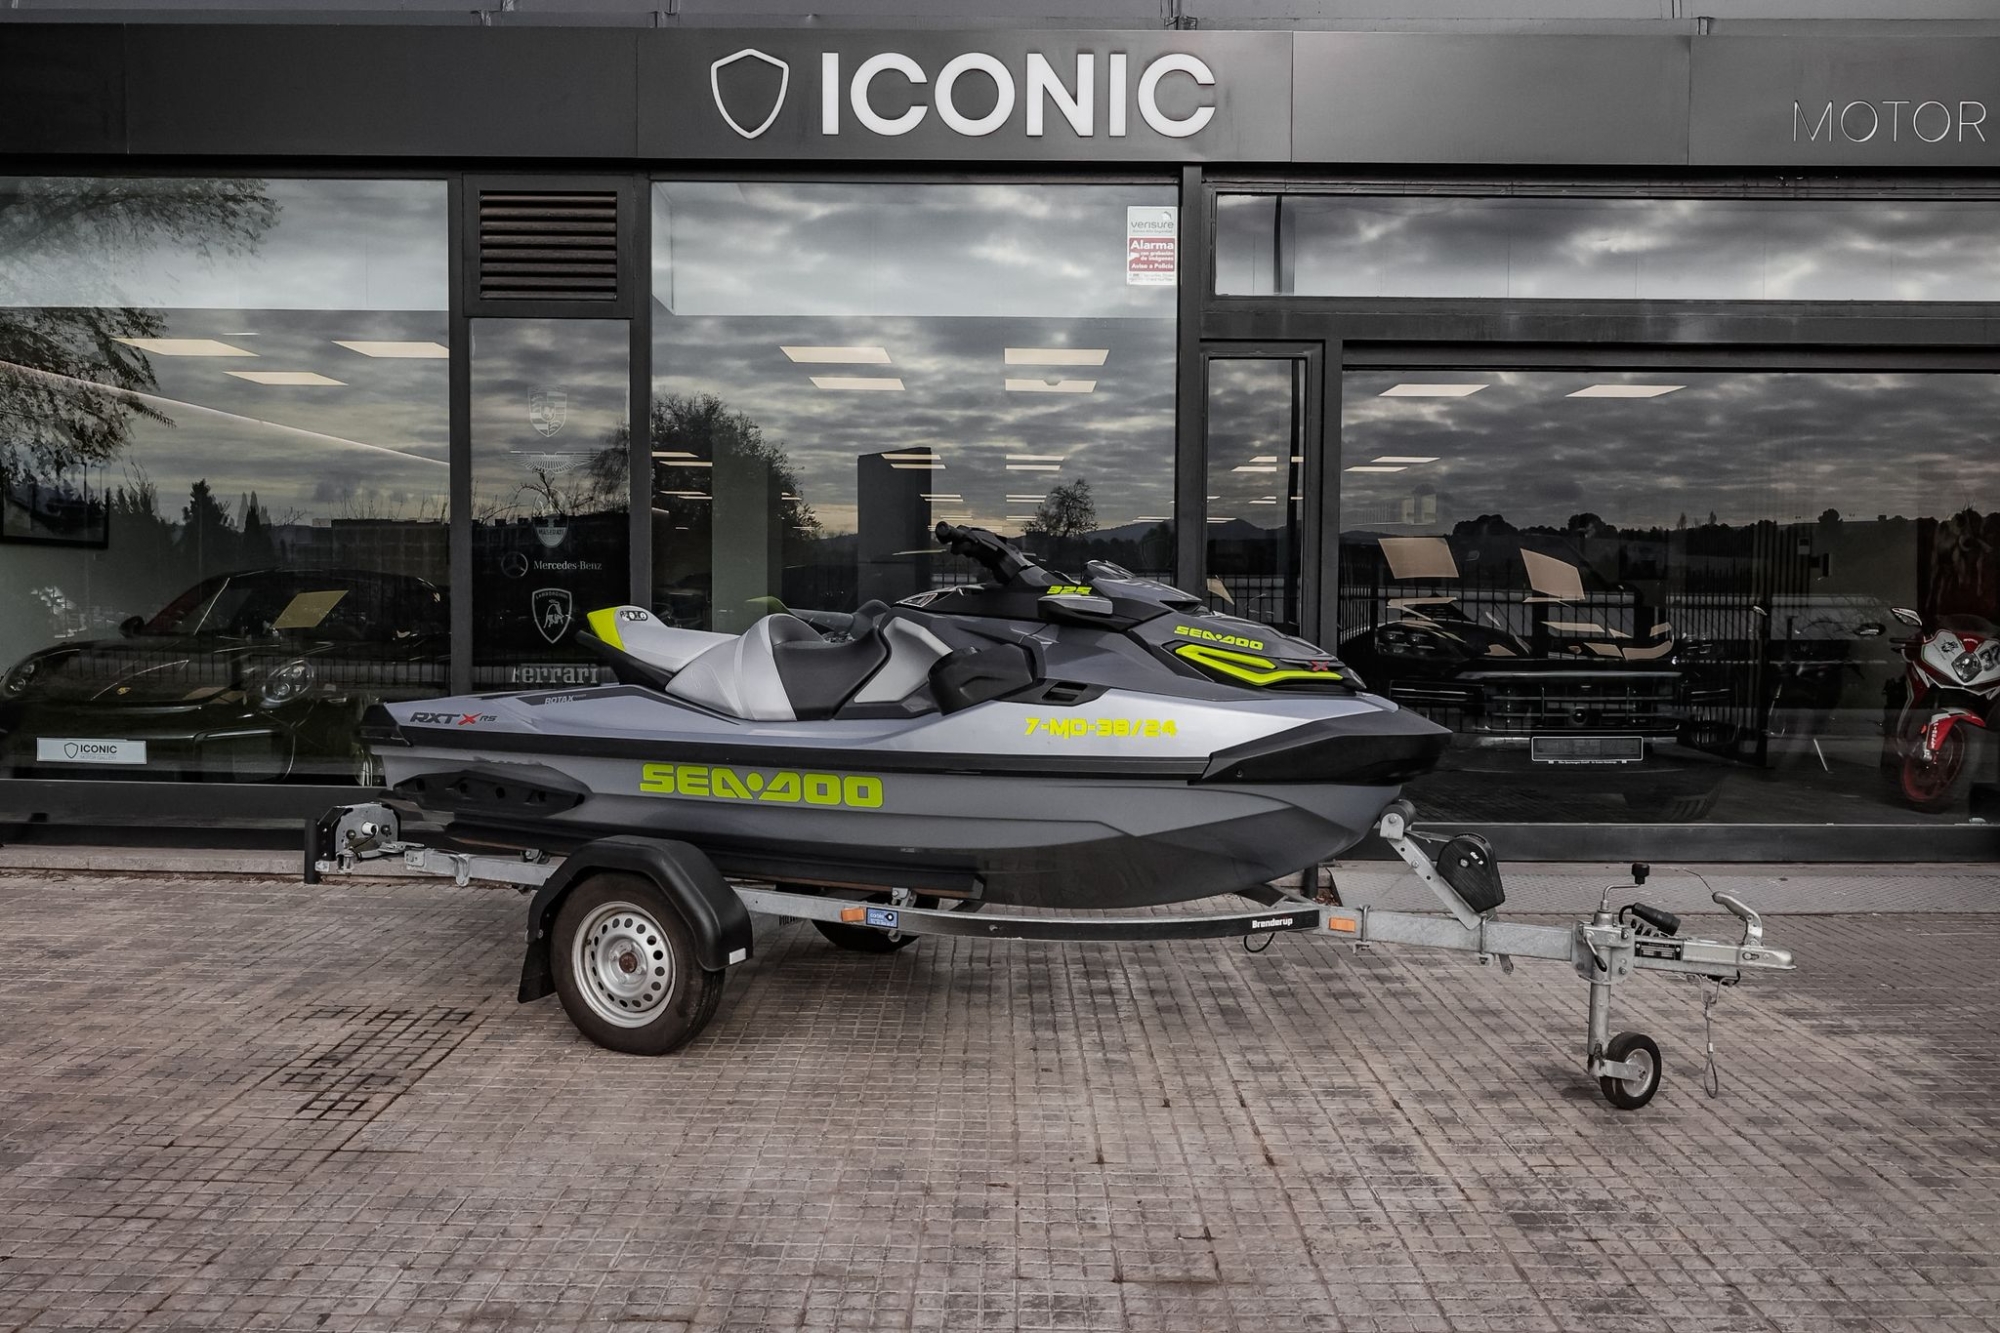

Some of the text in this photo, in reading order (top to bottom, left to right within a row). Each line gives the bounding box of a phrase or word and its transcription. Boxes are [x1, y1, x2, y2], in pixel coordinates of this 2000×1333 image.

[822, 52, 1216, 137] ICONIC
[1793, 100, 1987, 143] MOTOR
[1131, 221, 1174, 229] verisure
[1131, 240, 1174, 250] Alarma
[533, 560, 602, 570] Mercedes-Benz
[545, 695, 574, 705] ROTAX
[410, 712, 460, 724] RXT
[80, 744, 117, 754] ICONIC
[1252, 918, 1293, 929] Brenderup
